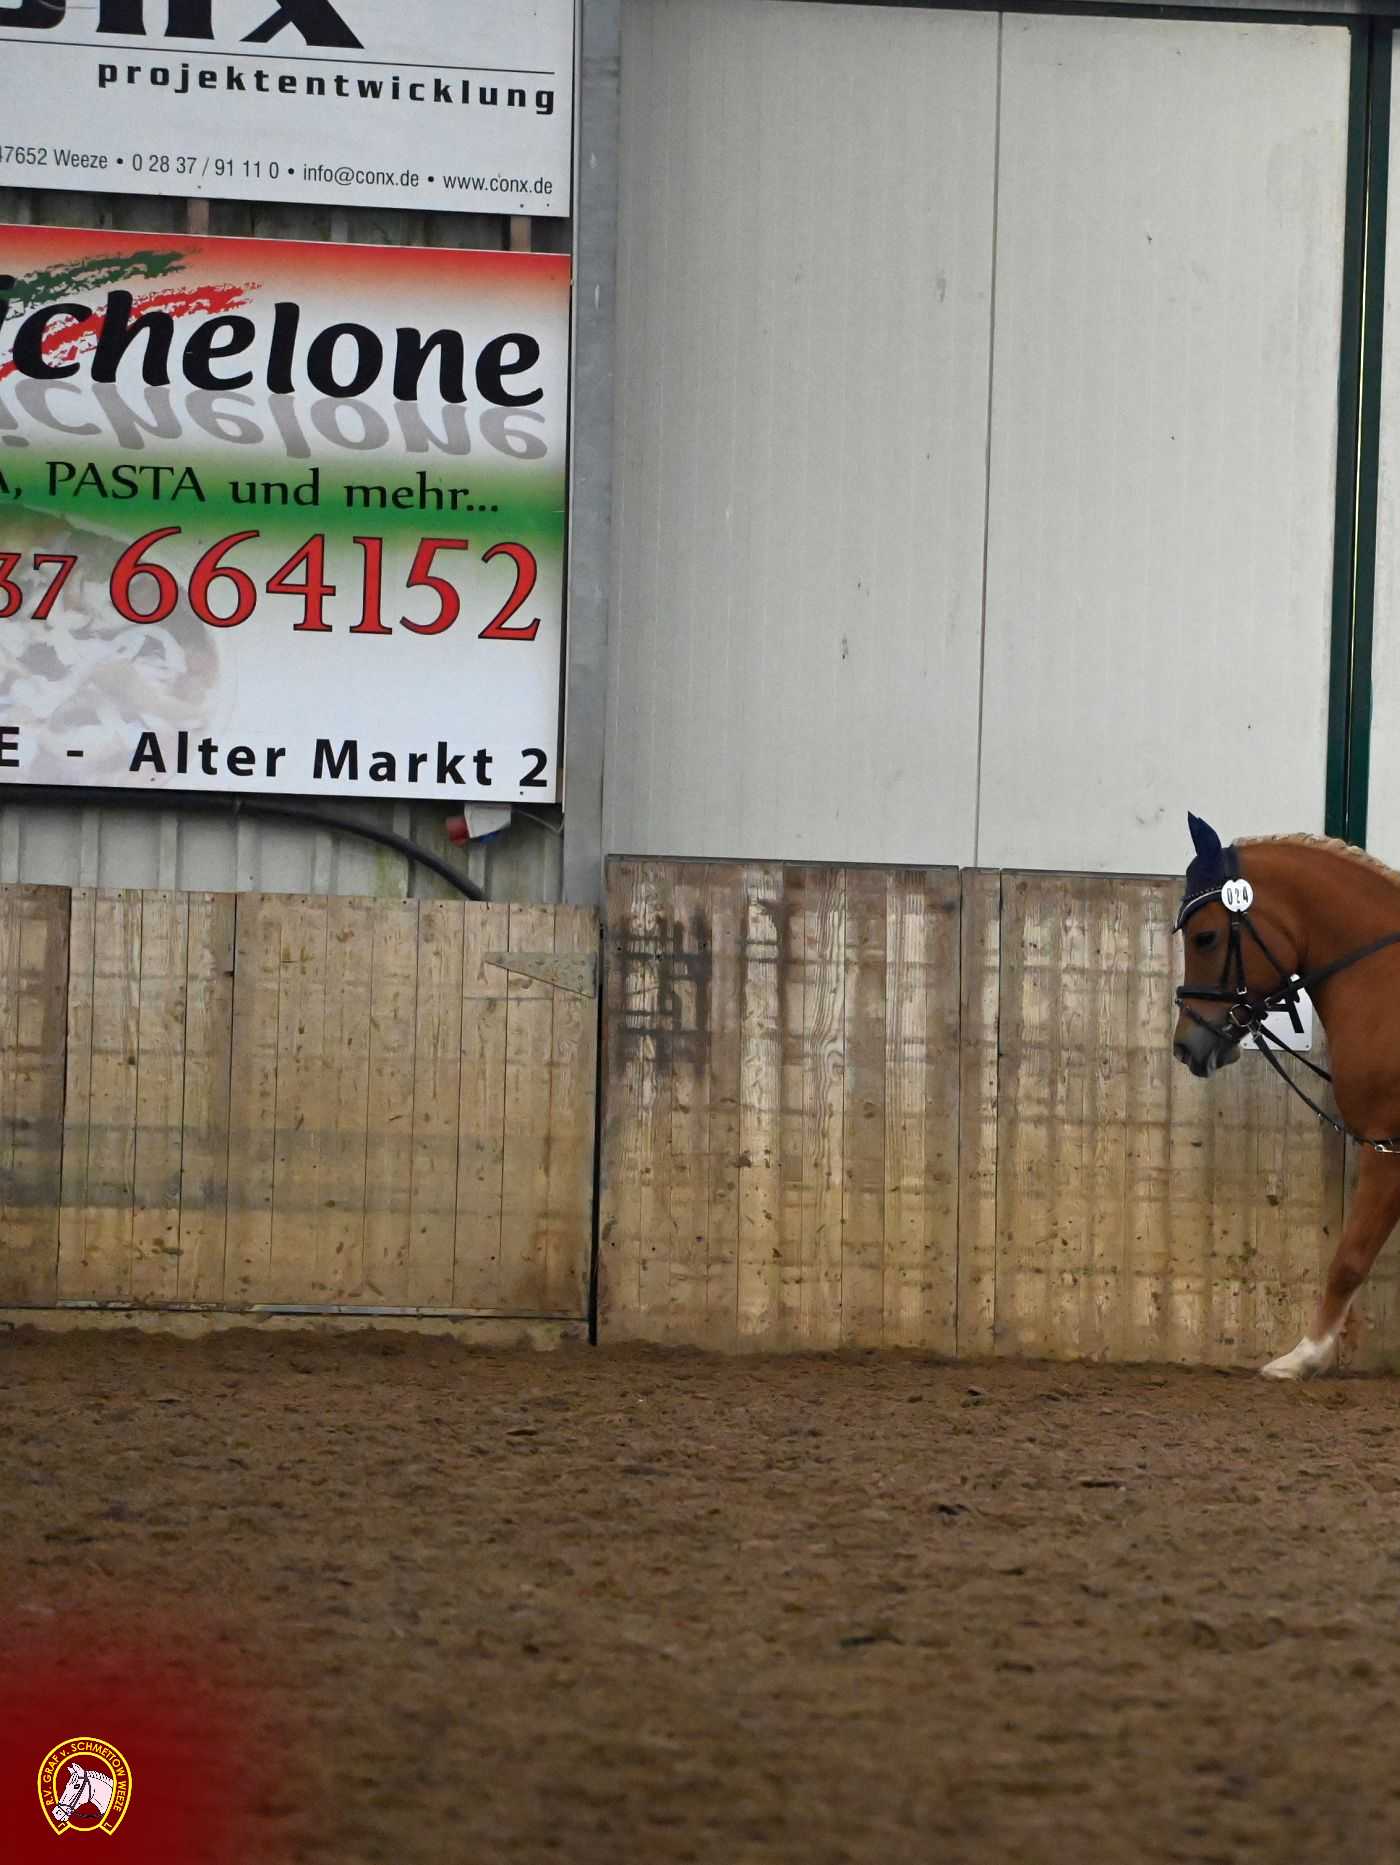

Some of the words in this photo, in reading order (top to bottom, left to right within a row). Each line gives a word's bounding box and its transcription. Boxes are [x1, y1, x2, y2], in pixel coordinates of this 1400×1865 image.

[98, 62, 556, 116] projektentwicklung
[0, 144, 48, 166] 7652
[53, 148, 108, 170] Weeze
[132, 153, 143, 172] 0
[148, 154, 170, 173] 28
[176, 156, 198, 175] 37
[214, 158, 233, 177] 91
[243, 159, 260, 178] 11
[269, 161, 279, 180] 0
[303, 164, 419, 188] info@conx.de
[443, 175, 553, 195] www.conx.de
[45, 461, 206, 503] PASTA
[228, 467, 320, 507] und
[343, 470, 499, 513] mehr...
[108, 525, 542, 642] 664152
[128, 730, 286, 778] Alter
[312, 738, 493, 786] Markt
[519, 747, 548, 788] 2
